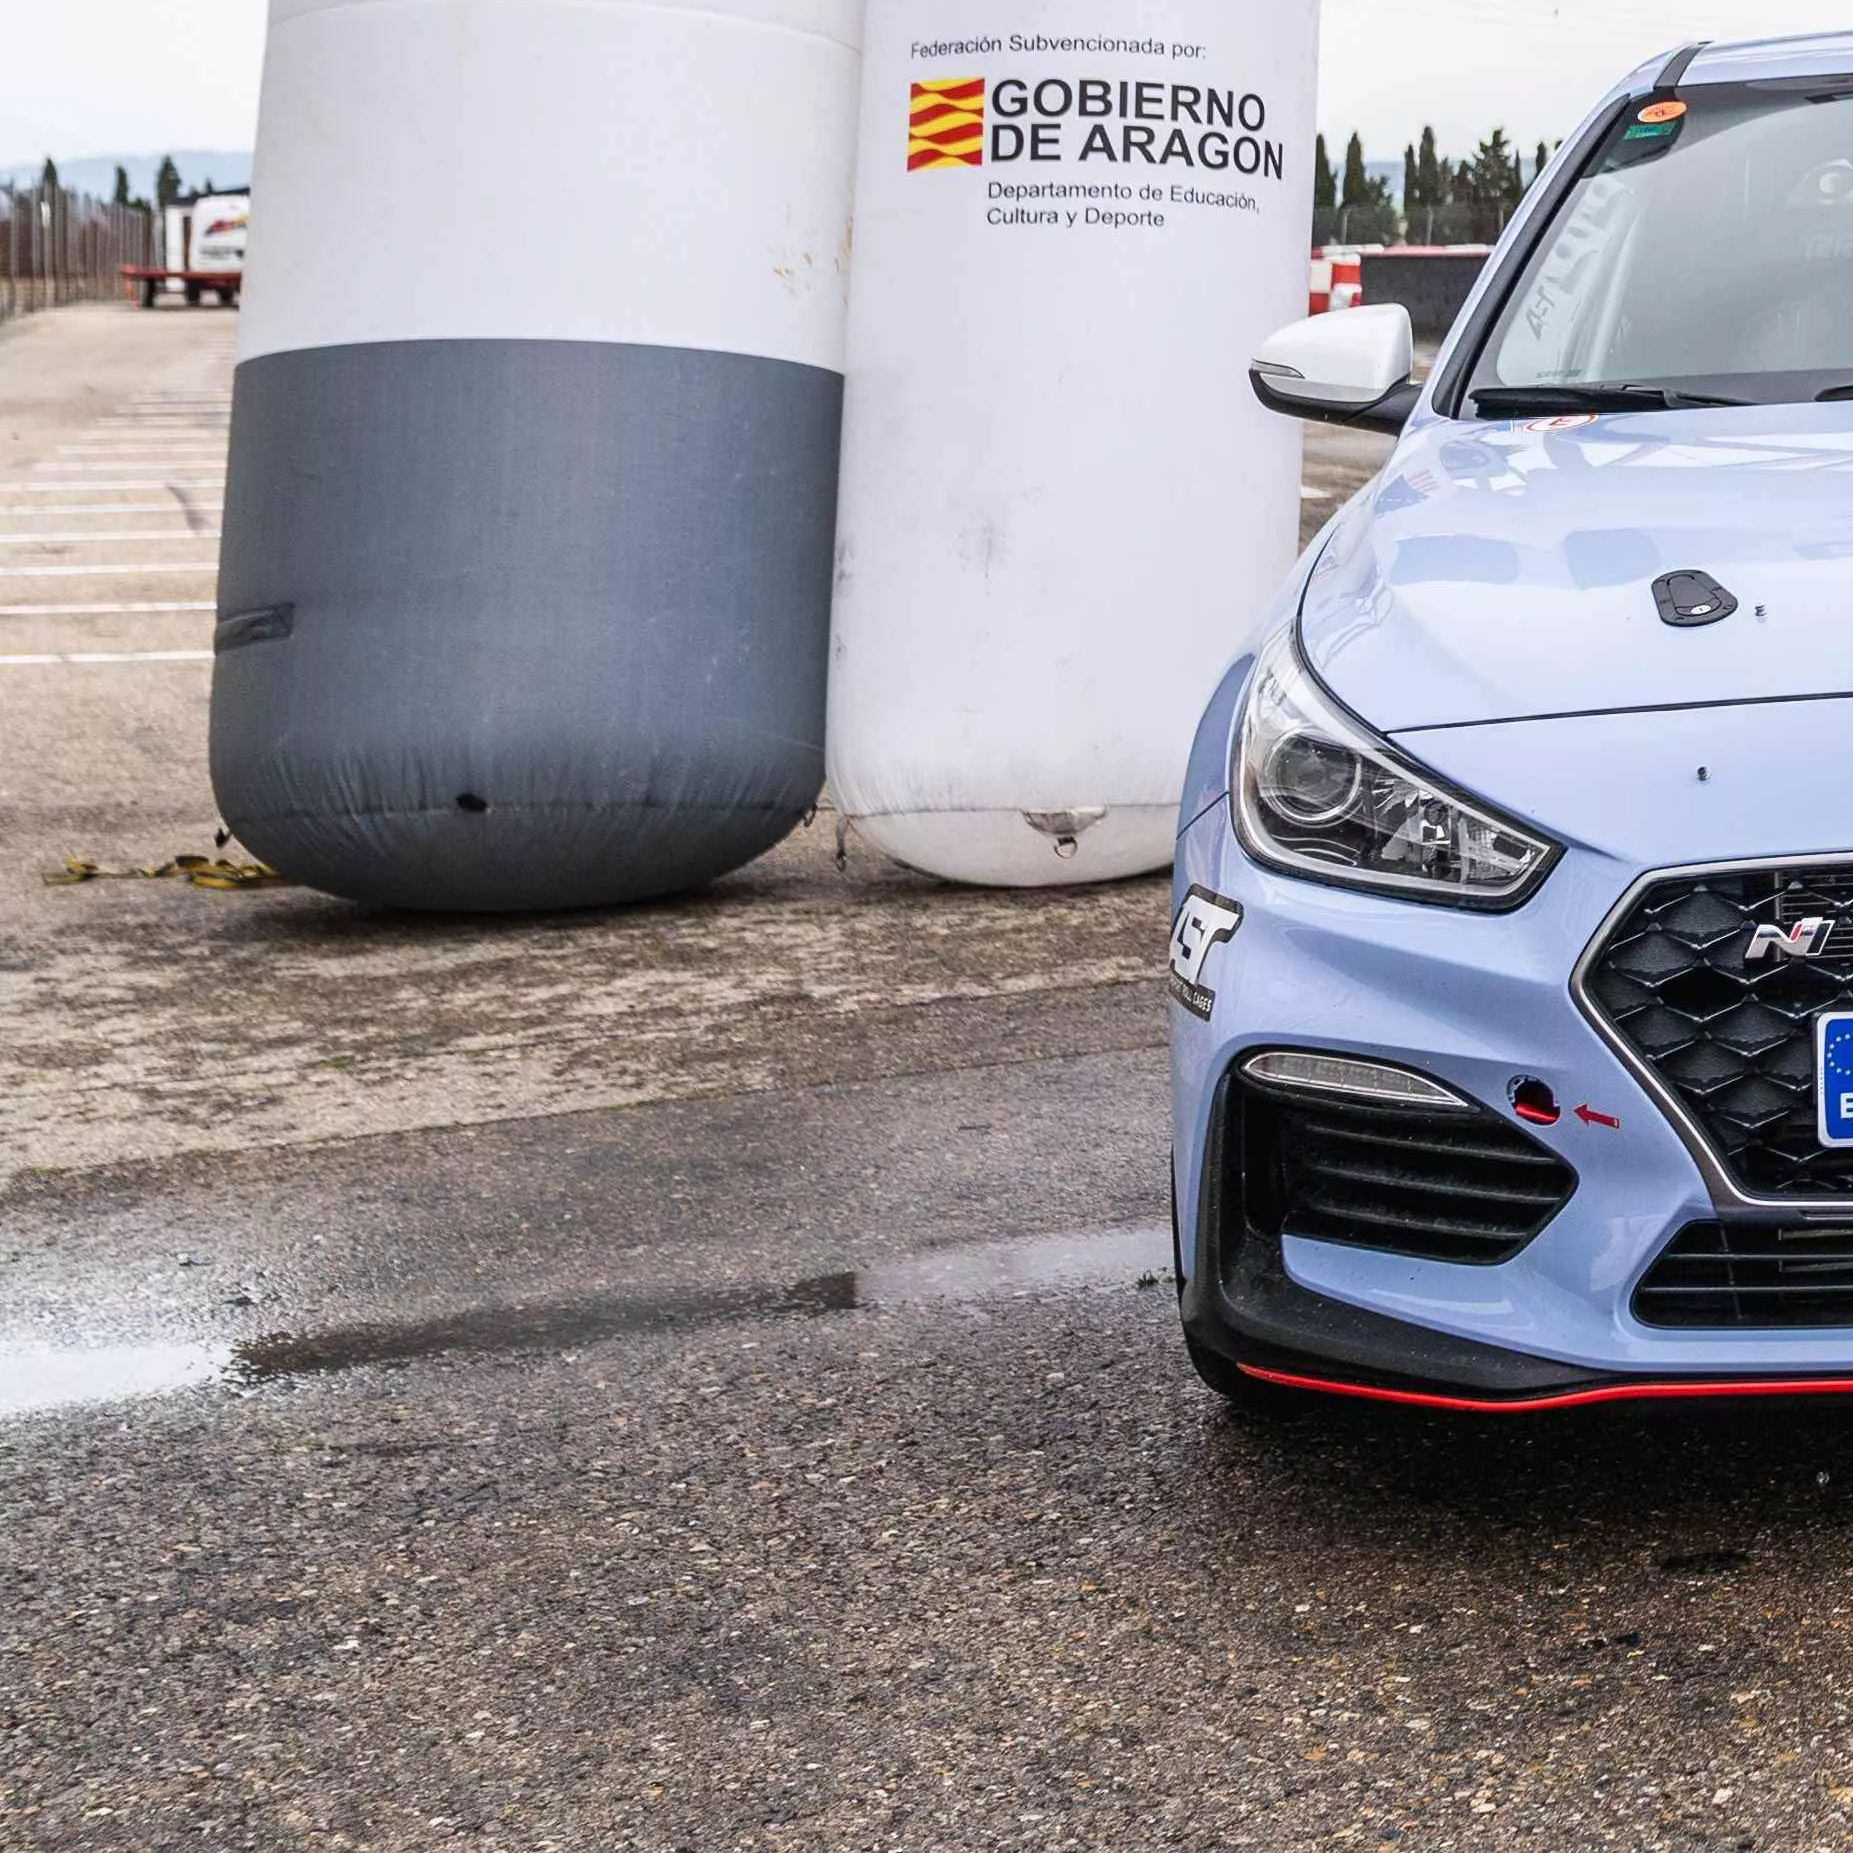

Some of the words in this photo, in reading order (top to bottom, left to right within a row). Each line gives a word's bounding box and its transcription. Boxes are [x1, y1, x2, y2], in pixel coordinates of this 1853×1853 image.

[910, 35, 1002, 60] Federación
[1008, 33, 1166, 55] Subvencionada
[1171, 43, 1207, 62] por:
[990, 78, 1266, 133] GOBIERNO
[990, 123, 1062, 163] DE
[1077, 123, 1285, 181] ARAGON
[987, 181, 1133, 204] Departamento
[1138, 183, 1164, 202] de
[1169, 184, 1261, 215] Educación,
[986, 206, 1060, 226] Cultura
[1065, 211, 1079, 229] y
[1084, 205, 1166, 229] Deporte
